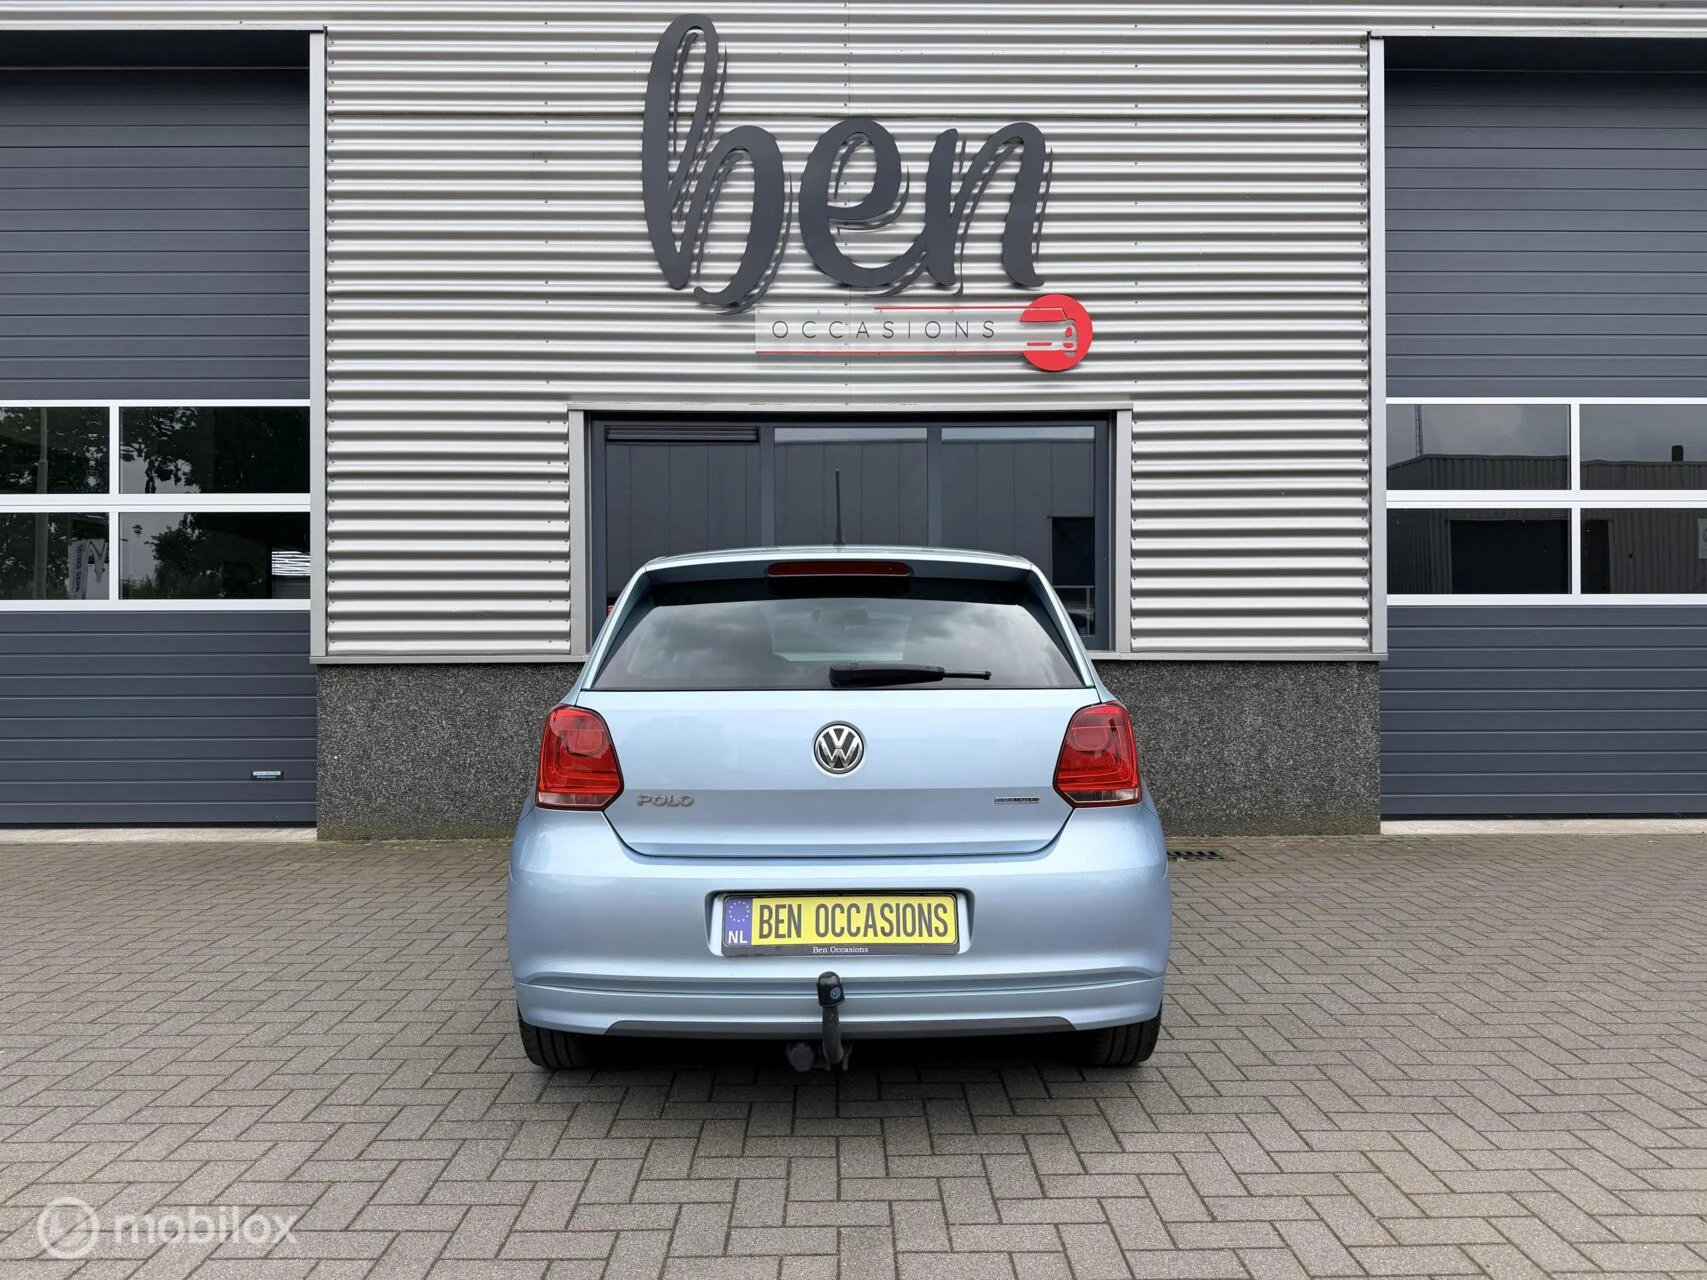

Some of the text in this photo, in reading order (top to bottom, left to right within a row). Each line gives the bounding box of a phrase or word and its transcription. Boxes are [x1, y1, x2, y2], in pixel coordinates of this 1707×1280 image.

[642, 14, 1046, 306] ben
[771, 319, 997, 340] OCCASIONS
[637, 794, 694, 807] POLO
[994, 797, 1040, 805] MOTION
[758, 902, 949, 939] BEN OCCASIONS
[728, 930, 748, 944] NL
[812, 946, 869, 954] Ben Occasions
